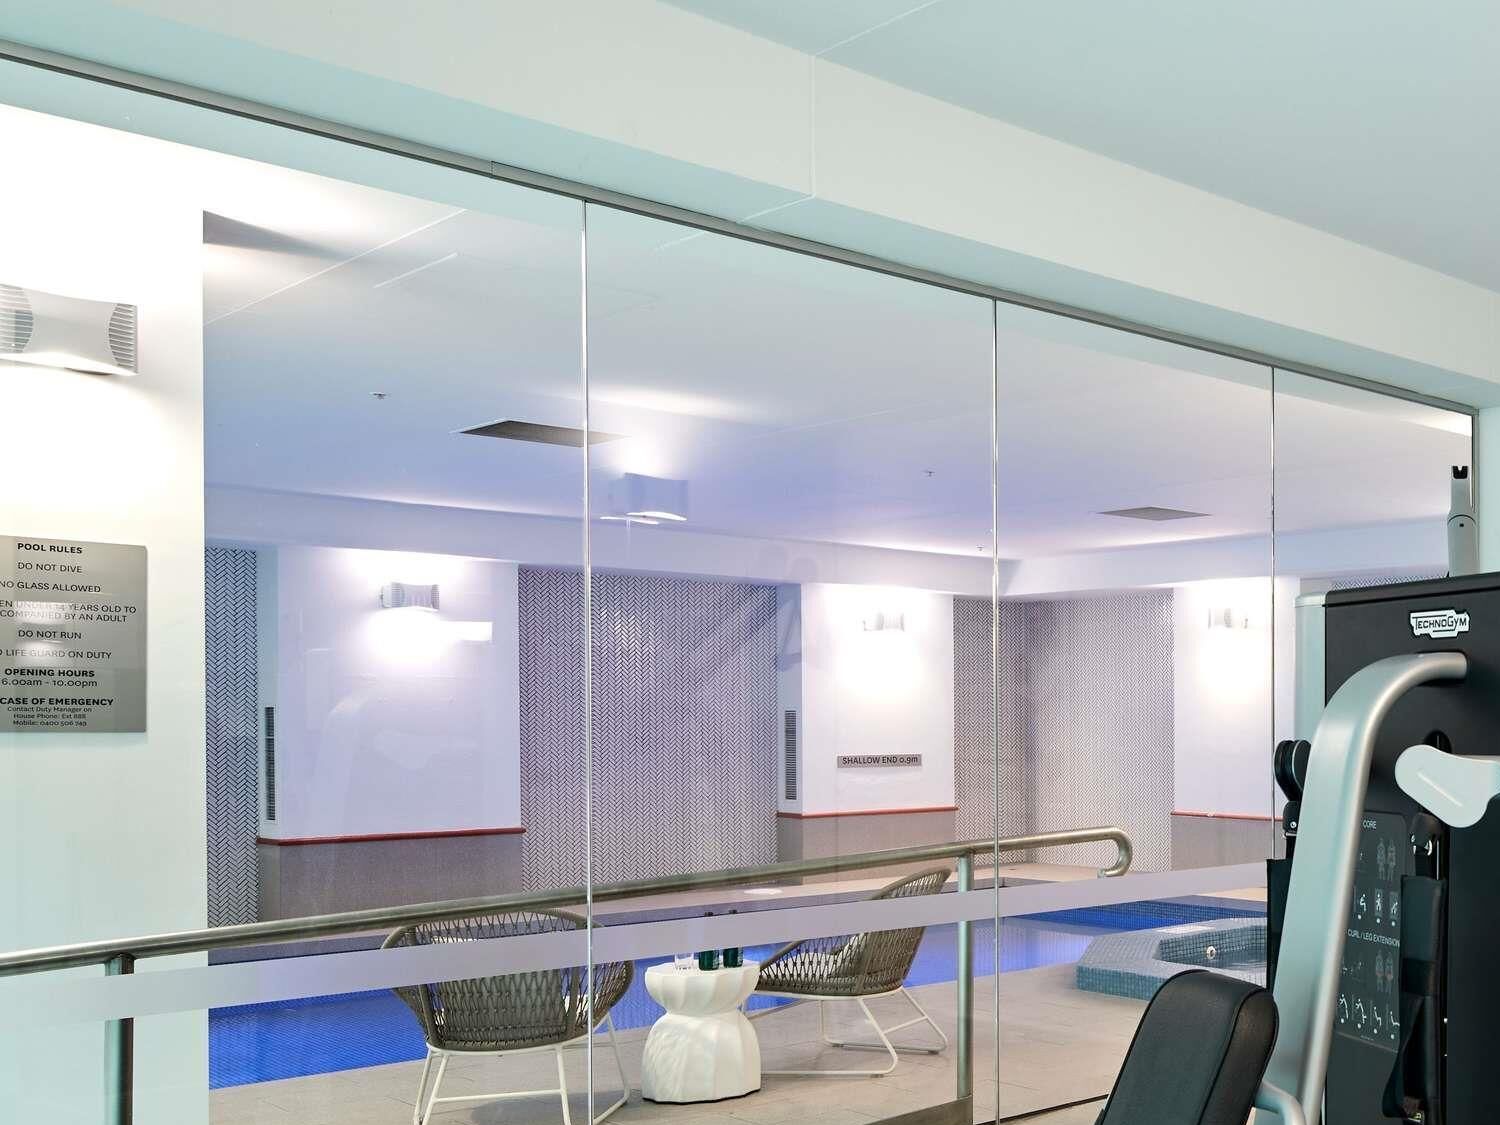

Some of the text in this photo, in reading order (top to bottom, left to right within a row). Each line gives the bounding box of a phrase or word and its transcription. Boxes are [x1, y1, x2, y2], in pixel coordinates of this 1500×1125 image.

[17, 542, 83, 554] POOL RULES
[18, 562, 83, 573] DO NOT DIVE
[17, 581, 49, 590] GLASS
[52, 583, 101, 593] ALLOWED
[70, 603, 99, 612] YEARS
[124, 606, 137, 614] TO
[64, 612, 76, 620] BY
[79, 613, 94, 621] AN
[96, 614, 127, 622] ADULT
[18, 630, 82, 639] DO NOT RUN
[86, 651, 112, 659] DUTY
[4, 668, 95, 678] OPENING HOURS
[2, 678, 42, 686] 6.00am
[0, 697, 29, 705] CASE
[48, 698, 114, 706] EMERGENCY
[842, 757, 880, 765] SHALLOW
[881, 756, 898, 764] END
[1362, 819, 1377, 829] CORE
